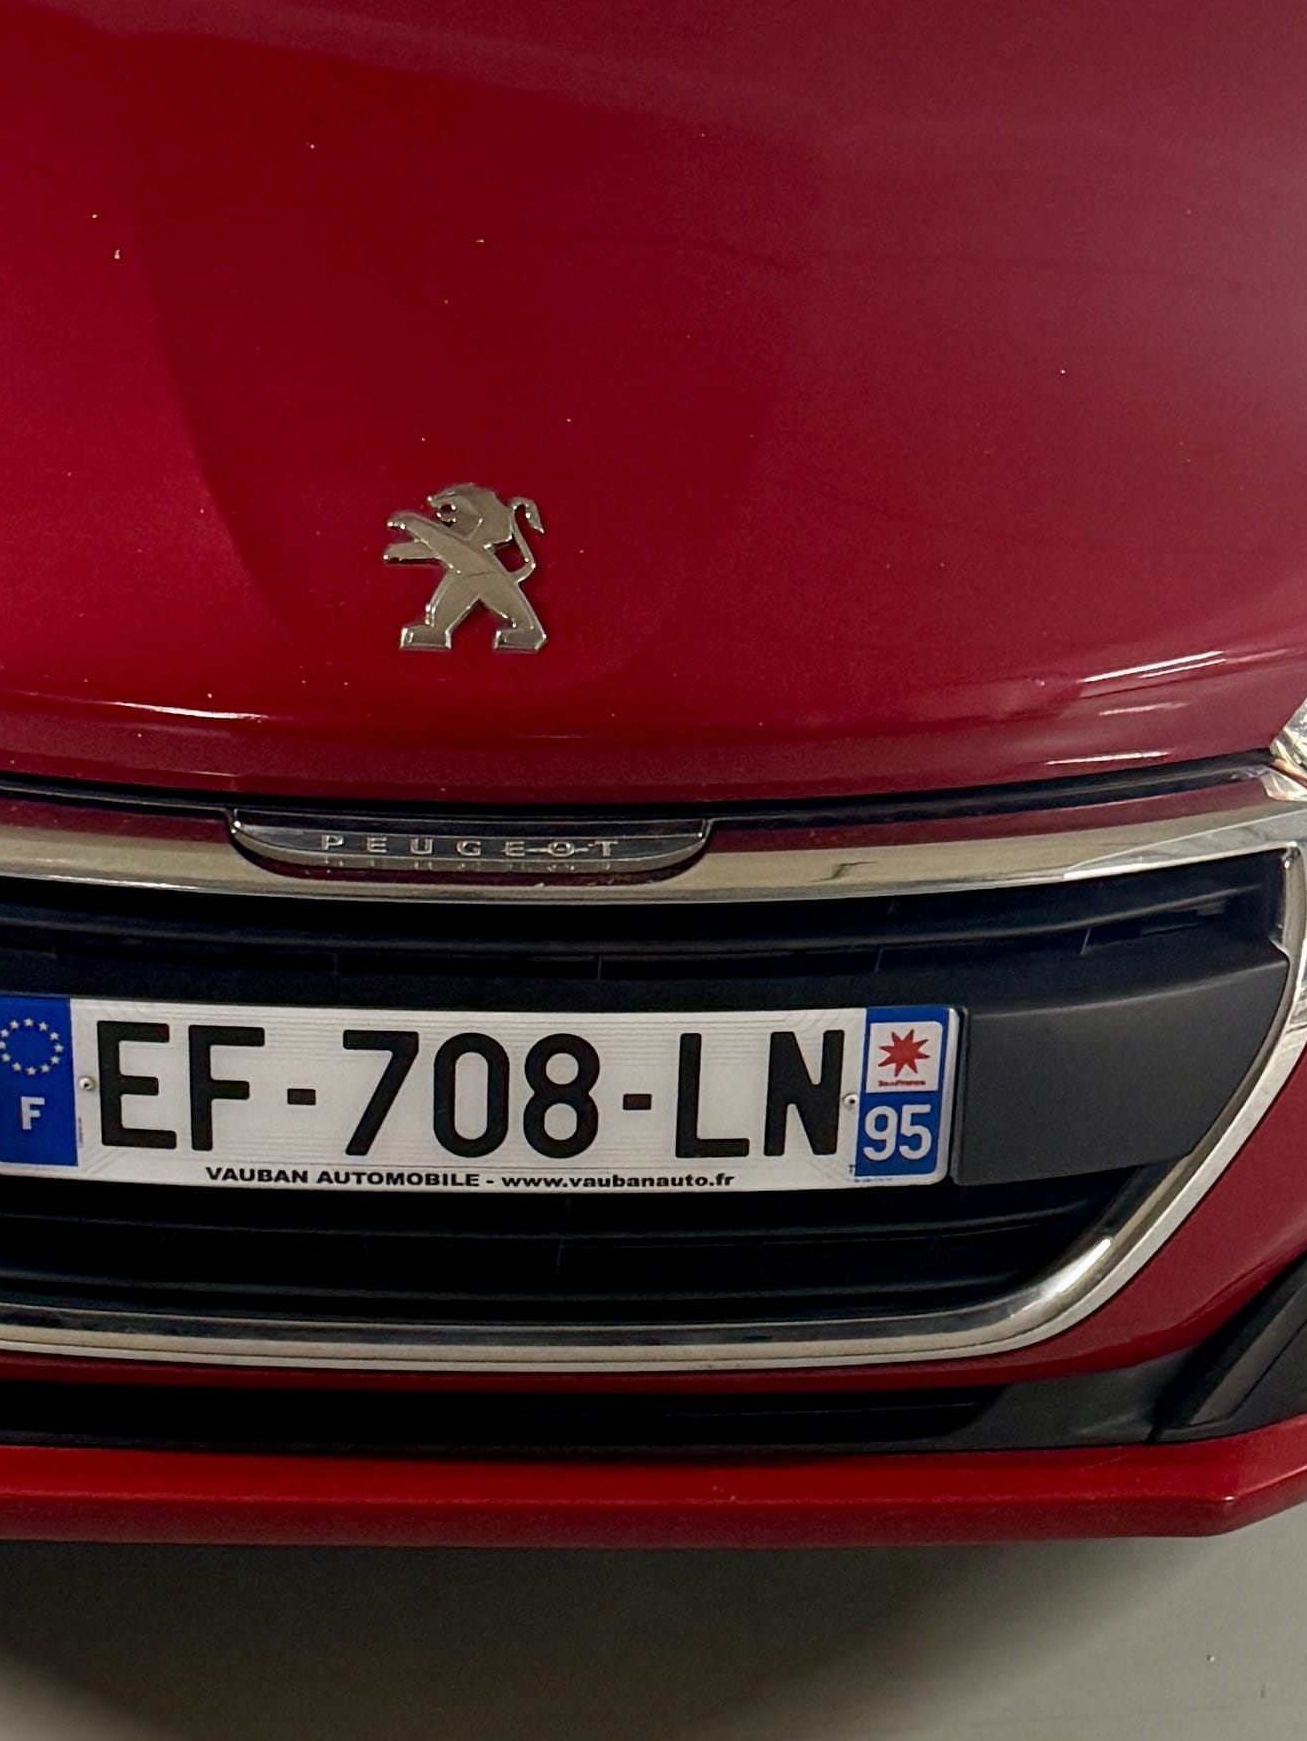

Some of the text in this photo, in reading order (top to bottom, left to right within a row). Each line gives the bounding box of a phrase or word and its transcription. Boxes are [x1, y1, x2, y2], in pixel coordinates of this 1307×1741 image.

[321, 834, 619, 858] PEUGEOT
[96, 1019, 845, 1160] EF-708-LN
[20, 1096, 46, 1131] F
[862, 1104, 933, 1162] 95
[205, 1166, 308, 1184] VAUBAN
[316, 1170, 481, 1187] AUTOMOBILE
[501, 1172, 736, 1188] www.vaubanauto.fr
